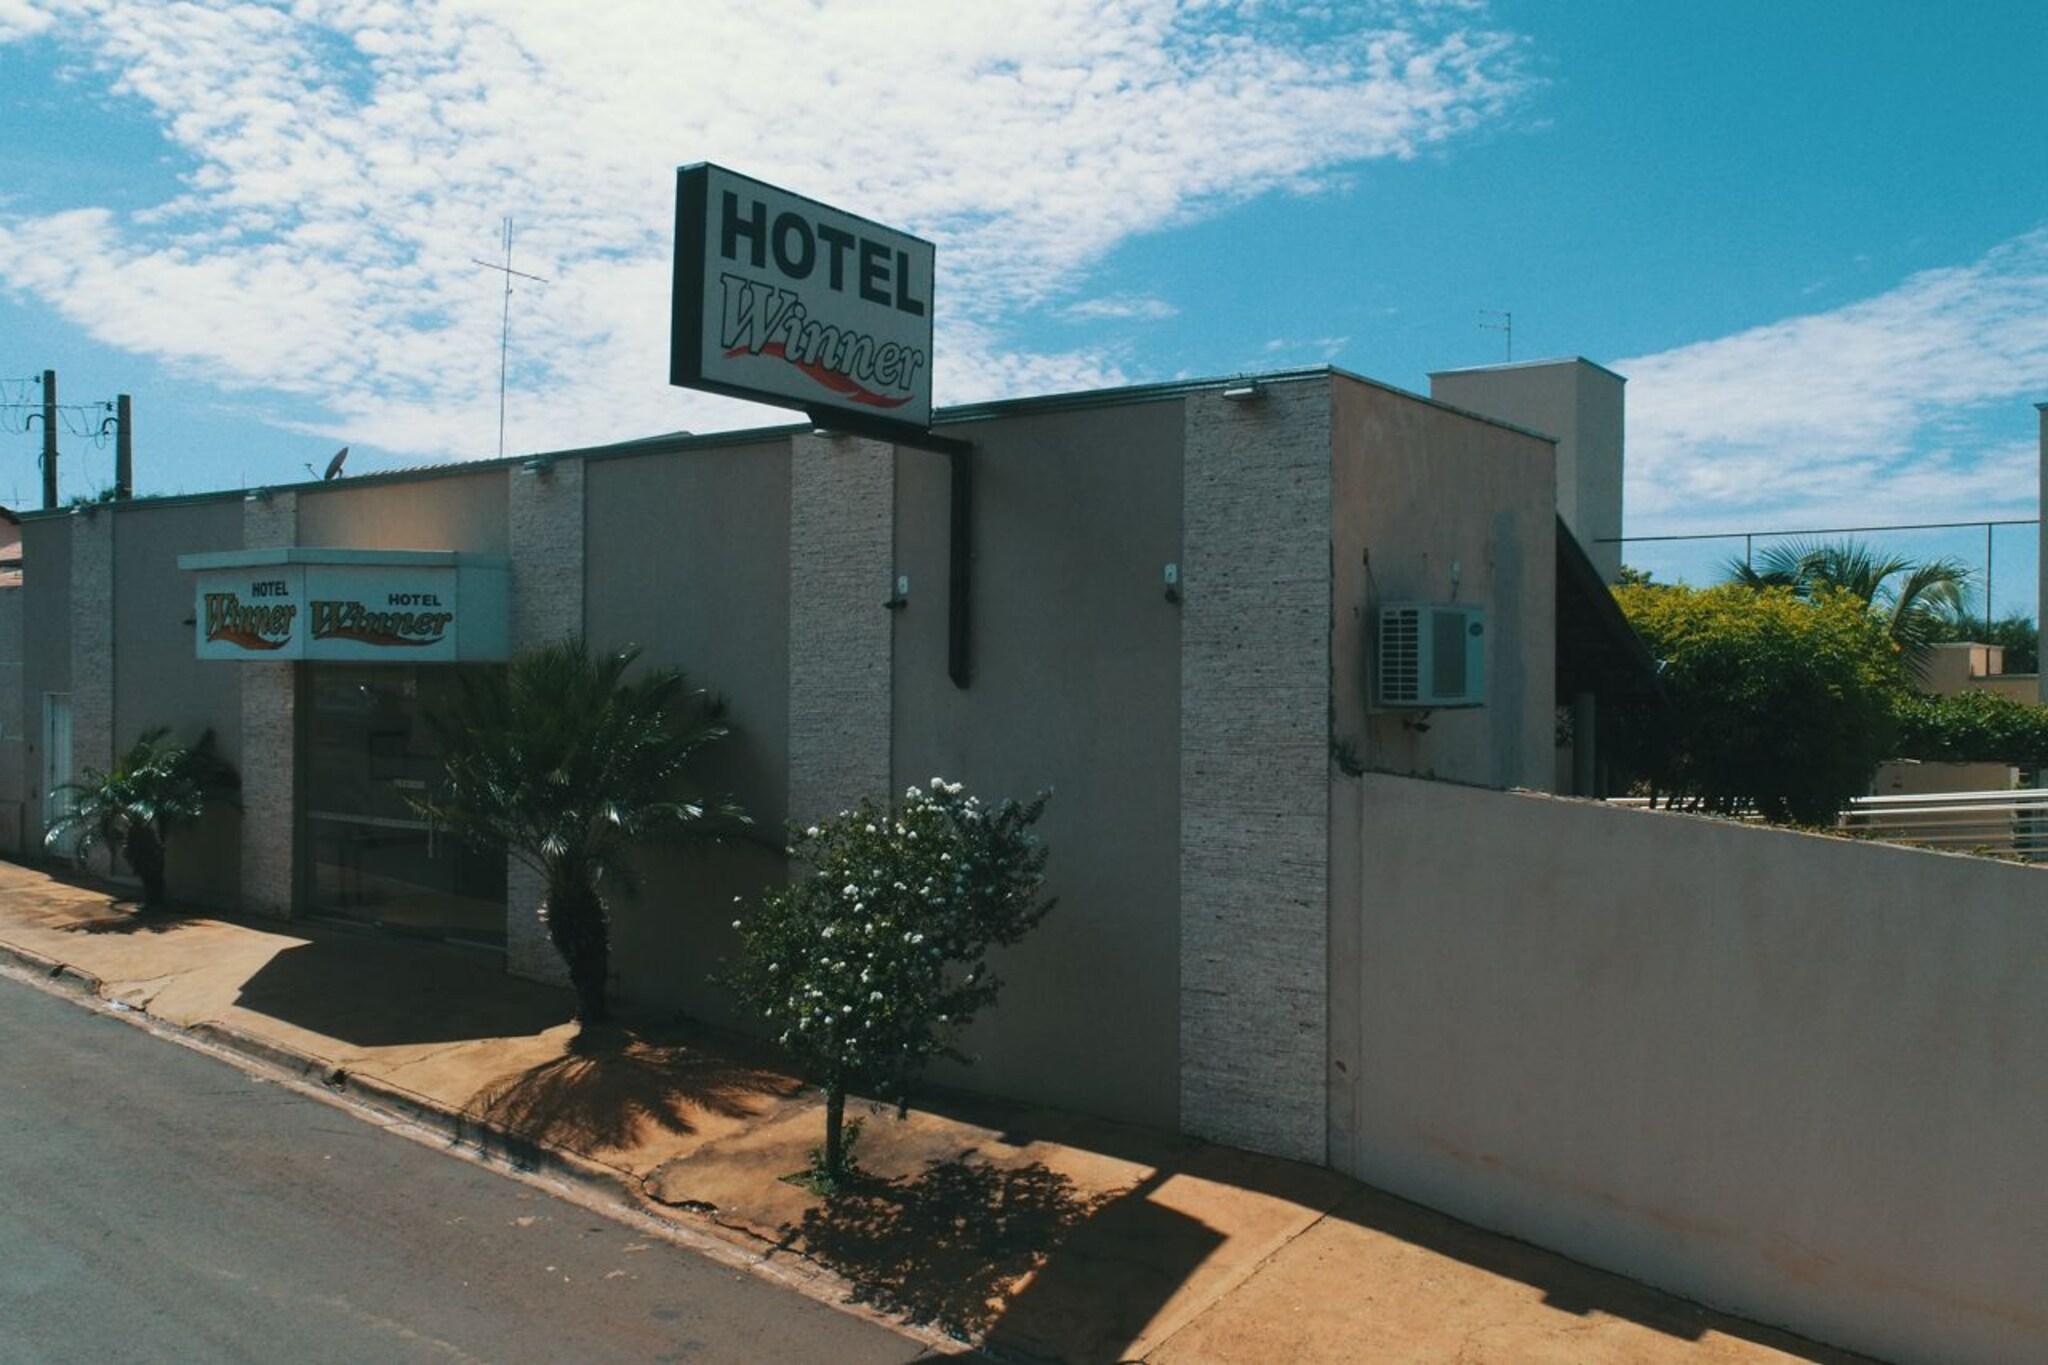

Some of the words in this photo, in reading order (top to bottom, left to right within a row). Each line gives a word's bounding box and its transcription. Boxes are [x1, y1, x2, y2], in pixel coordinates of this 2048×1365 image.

[721, 189, 925, 317] HOTEL
[720, 271, 924, 390] Winner
[252, 581, 288, 597] HOTEL
[388, 594, 441, 606] HOTEL
[204, 593, 296, 636] Winner
[310, 601, 452, 635] Winner
